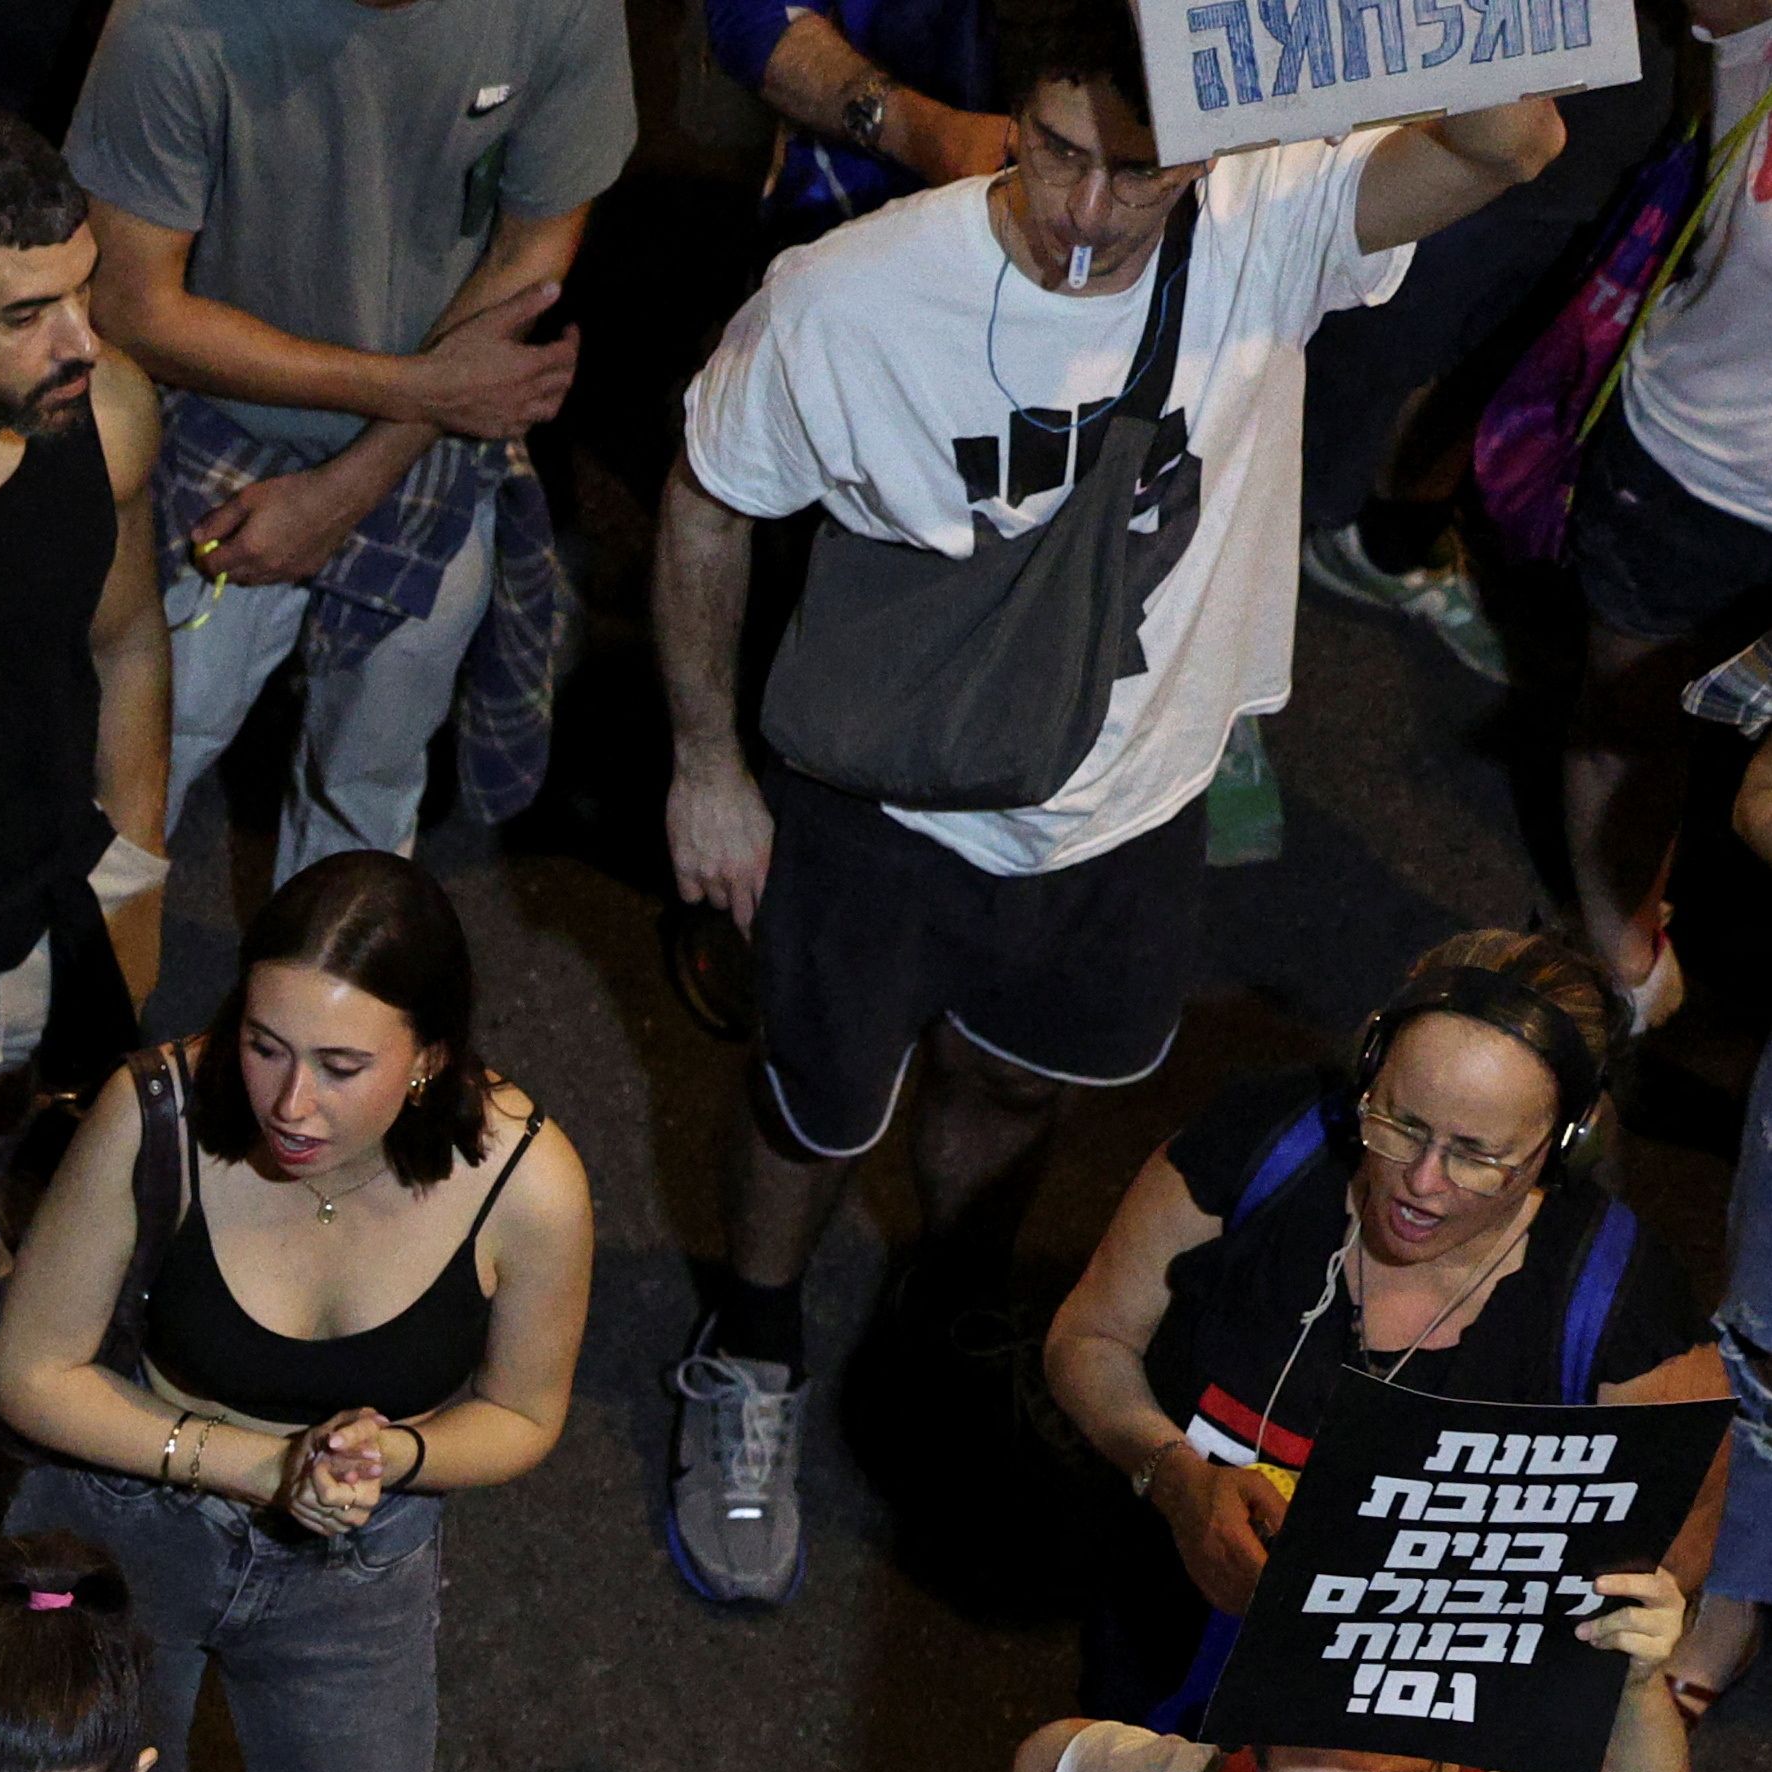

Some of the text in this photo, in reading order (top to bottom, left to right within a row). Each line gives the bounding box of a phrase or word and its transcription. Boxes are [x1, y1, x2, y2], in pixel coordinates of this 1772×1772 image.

[1423, 1430, 1618, 1475] שנת
[1357, 1475, 1639, 1523] השבת
[1383, 1529, 1569, 1572] בנים
[1302, 1571, 1606, 1616] לגבולם
[1322, 1621, 1544, 1665] ובנות
[1346, 1663, 1477, 1723] גם!
